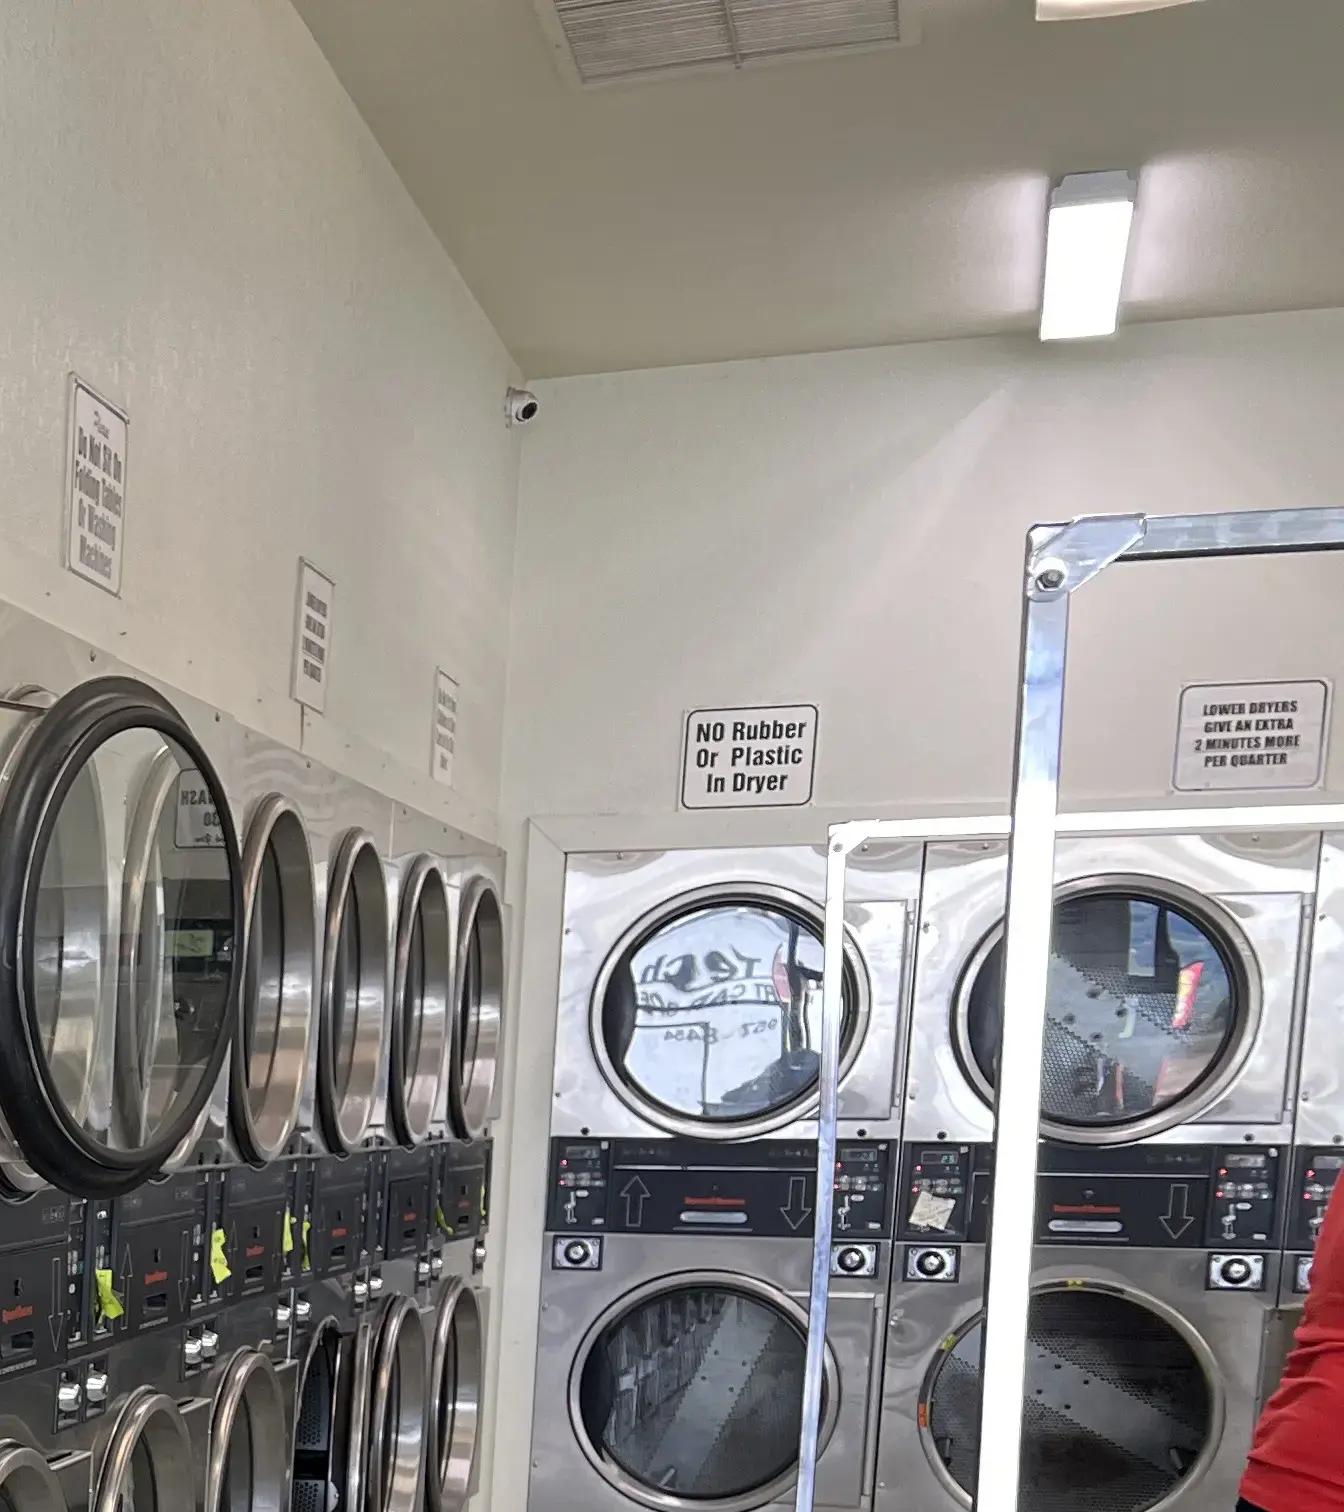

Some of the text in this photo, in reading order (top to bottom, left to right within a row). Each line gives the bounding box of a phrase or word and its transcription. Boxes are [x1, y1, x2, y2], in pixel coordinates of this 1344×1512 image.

[1203, 700, 1298, 716] LOWER DRYERS
[696, 720, 807, 743] NO Rubber
[1204, 718, 1294, 733] GIVE AN EXTRA
[1194, 735, 1301, 751] 2 MINUTES MORE
[696, 745, 803, 768] Or Plastic
[1204, 753, 1288, 767] PER QUARTER
[707, 772, 788, 793] In Dryer
